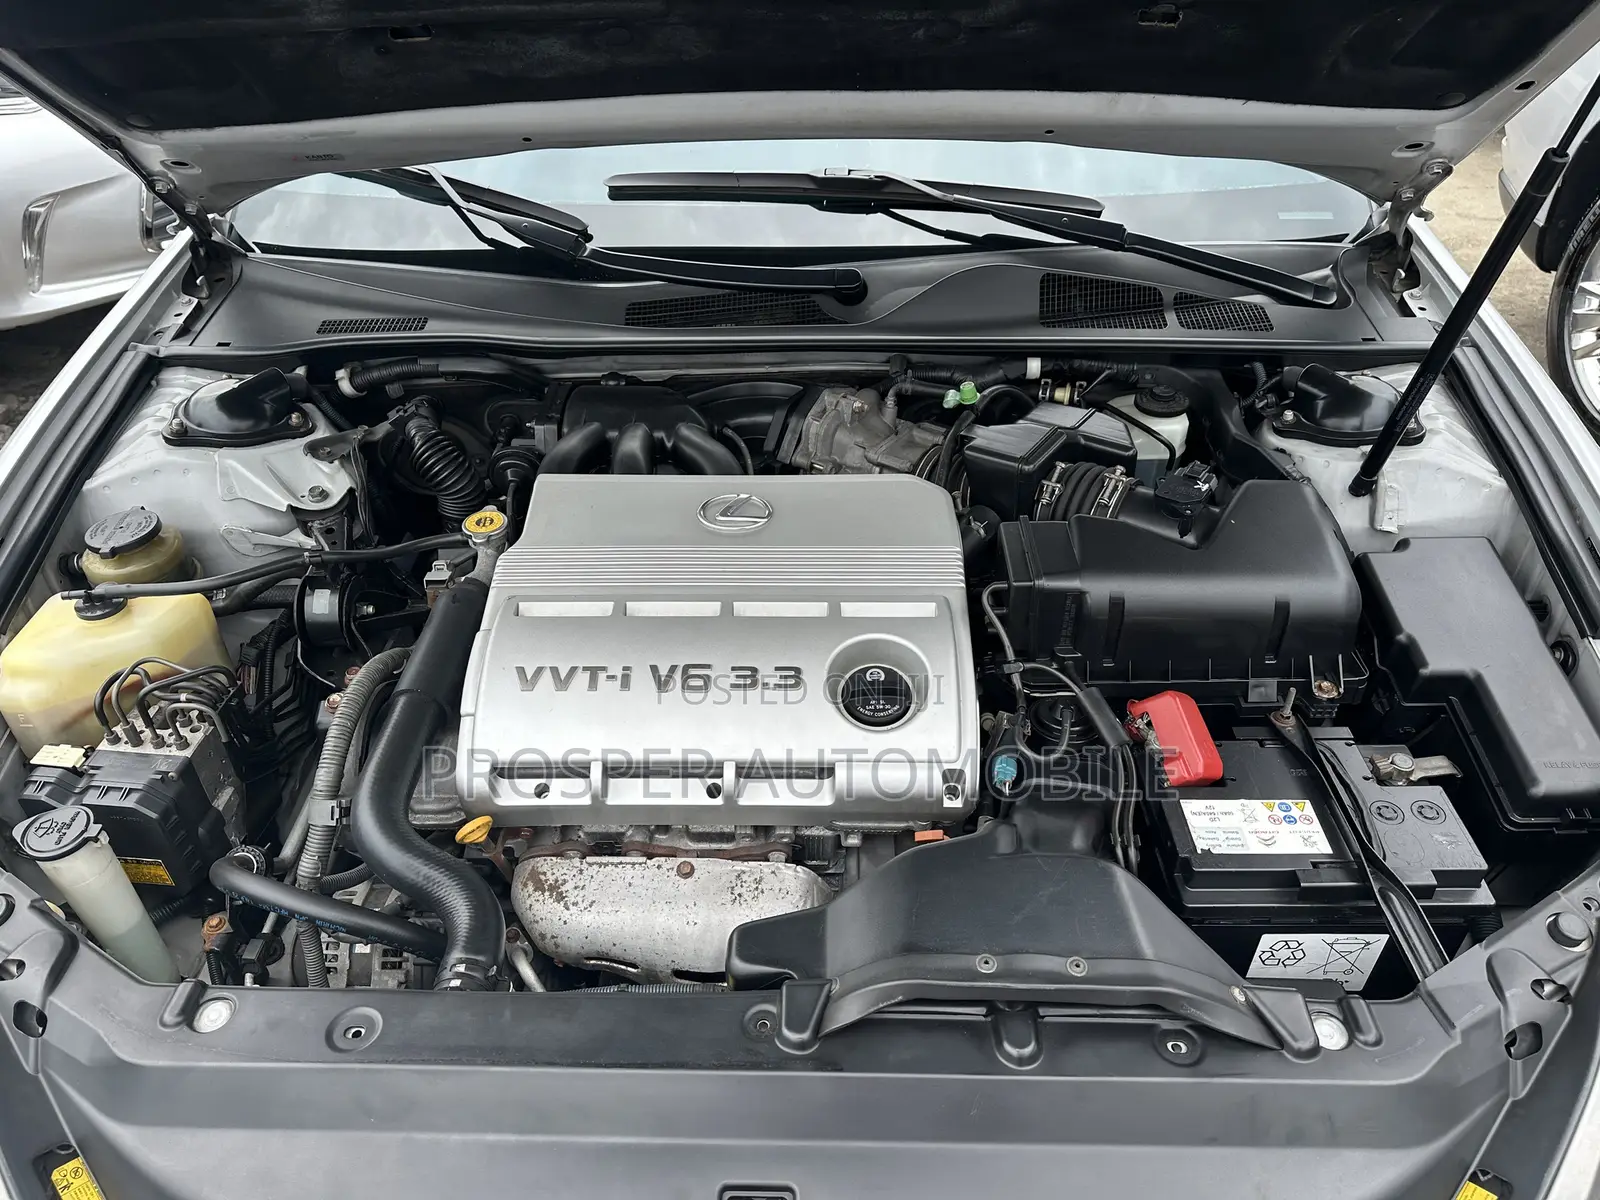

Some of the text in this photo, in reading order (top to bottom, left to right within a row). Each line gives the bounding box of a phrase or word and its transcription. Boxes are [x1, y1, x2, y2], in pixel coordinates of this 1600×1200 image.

[515, 663, 804, 693] VVT-i V6 3.3
